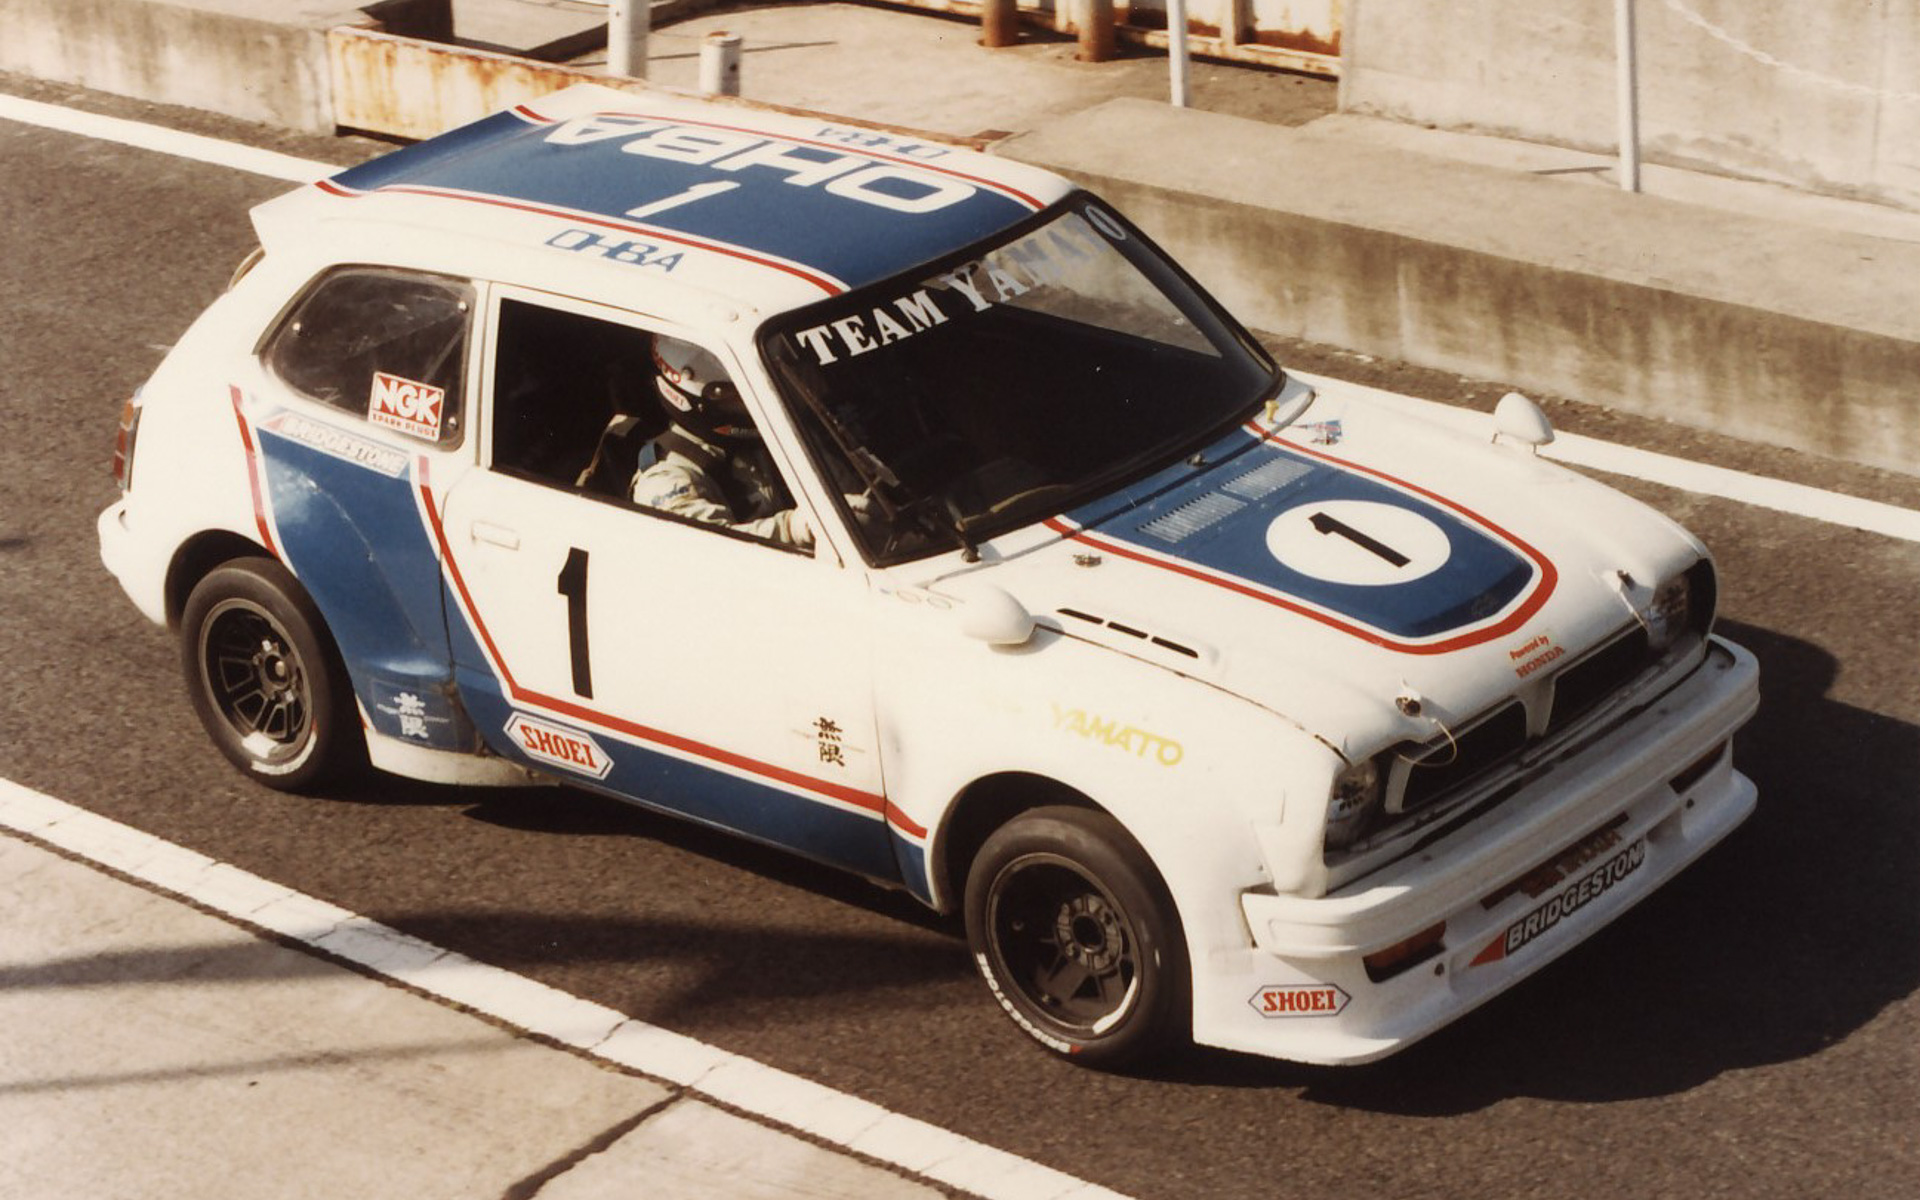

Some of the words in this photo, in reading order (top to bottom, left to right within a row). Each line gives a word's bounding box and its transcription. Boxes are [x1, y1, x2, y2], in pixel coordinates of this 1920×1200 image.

[543, 117, 977, 213] OHBA
[625, 180, 740, 218] 1
[545, 228, 685, 272] OHBA
[796, 289, 949, 366] TEAM
[374, 378, 441, 426] NGK
[1308, 511, 1412, 568] 1
[557, 546, 594, 700] 1
[1515, 645, 1565, 678] HONDA
[519, 723, 598, 770] SHOEI
[1050, 702, 1184, 767] YAMATO
[1262, 990, 1337, 1013] SHOEI
